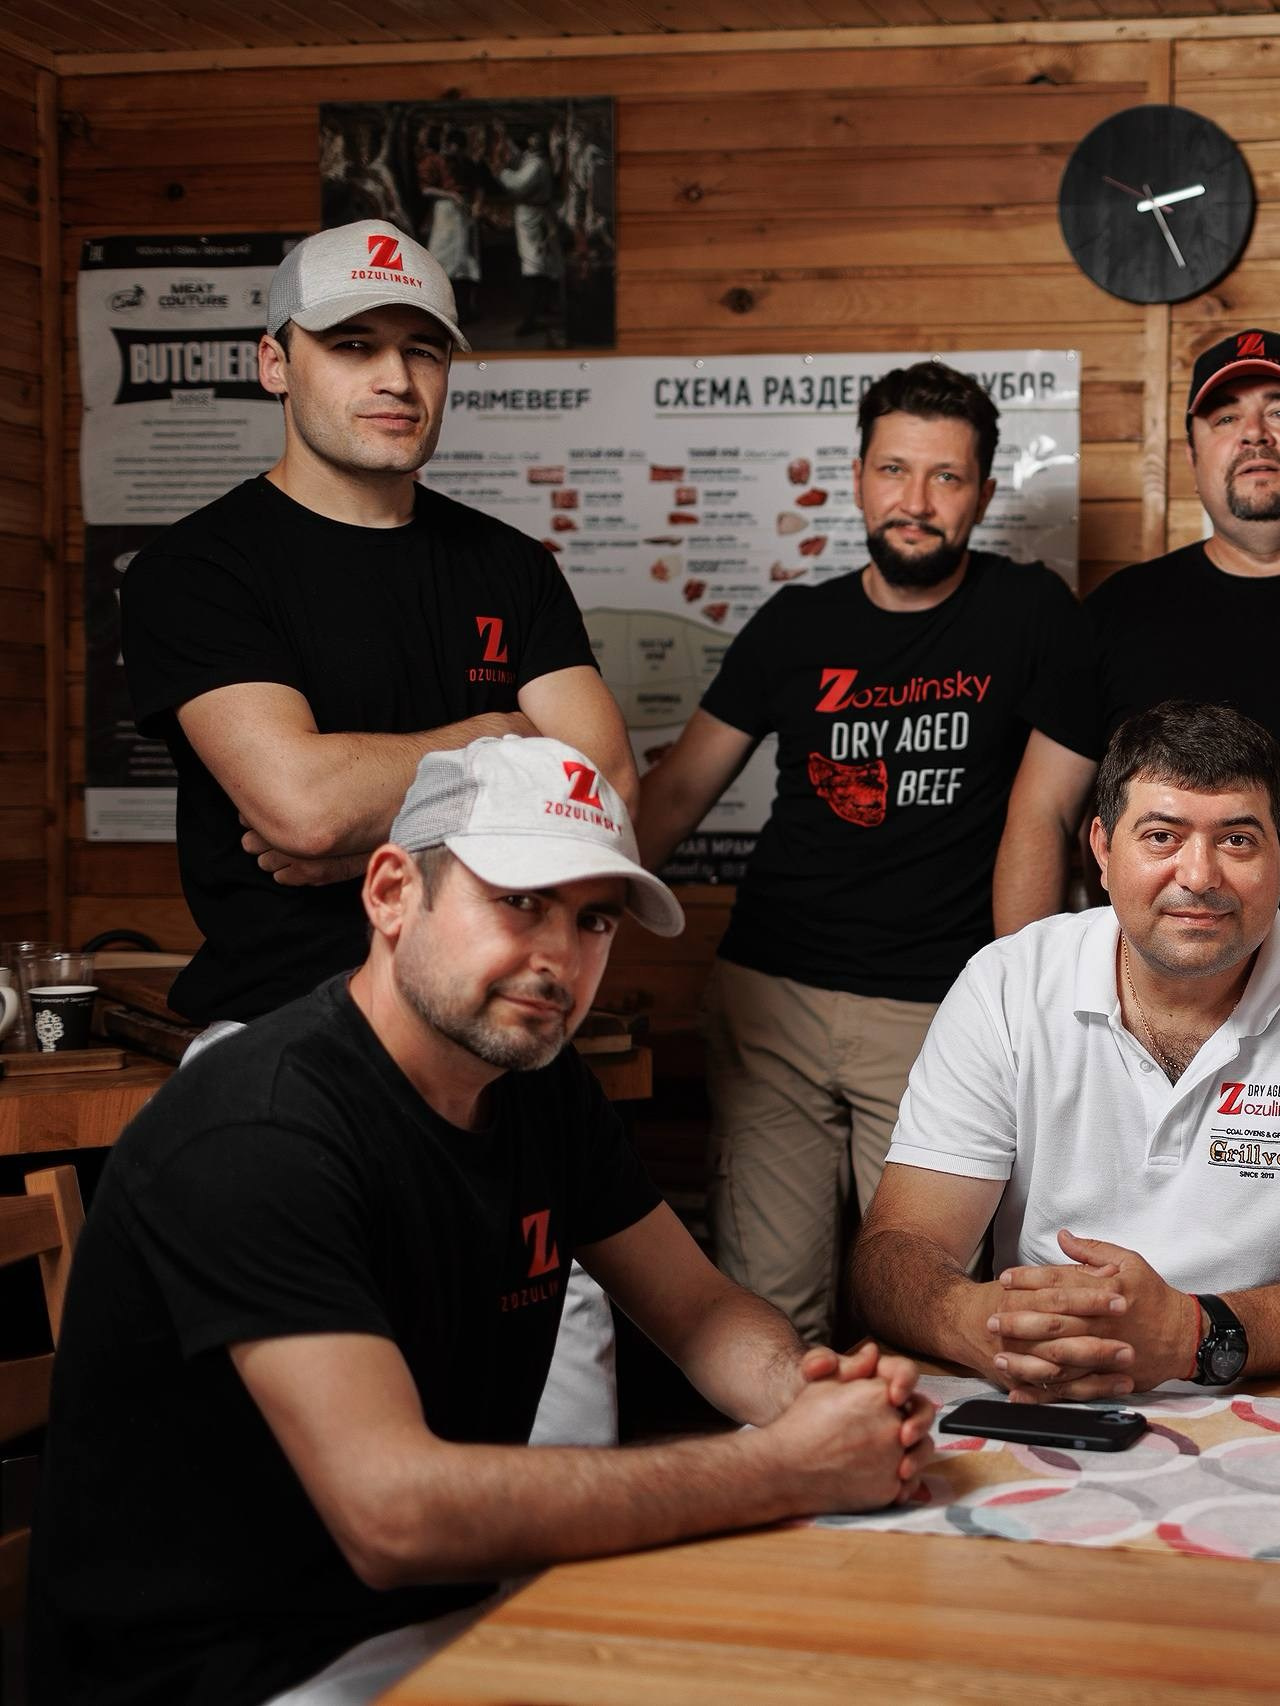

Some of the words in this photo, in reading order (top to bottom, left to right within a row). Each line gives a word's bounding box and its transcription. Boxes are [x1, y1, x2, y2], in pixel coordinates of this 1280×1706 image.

[367, 234, 404, 272] Z
[351, 270, 423, 289] ZOZULINSKY
[451, 388, 591, 411] PRIMEBEEF
[654, 376, 753, 408] СХЕМА
[475, 615, 508, 663] Z
[815, 668, 991, 713] Zozulinsky
[831, 720, 890, 761] DRY
[894, 711, 970, 754] AGED
[561, 760, 604, 812] Z
[896, 768, 965, 807] BEEF
[1248, 1084, 1266, 1097] DRY
[1226, 1128, 1243, 1136] COAL
[1244, 1129, 1266, 1138] OVENS
[1239, 1170, 1259, 1178] SINCE
[521, 1208, 560, 1279] Z
